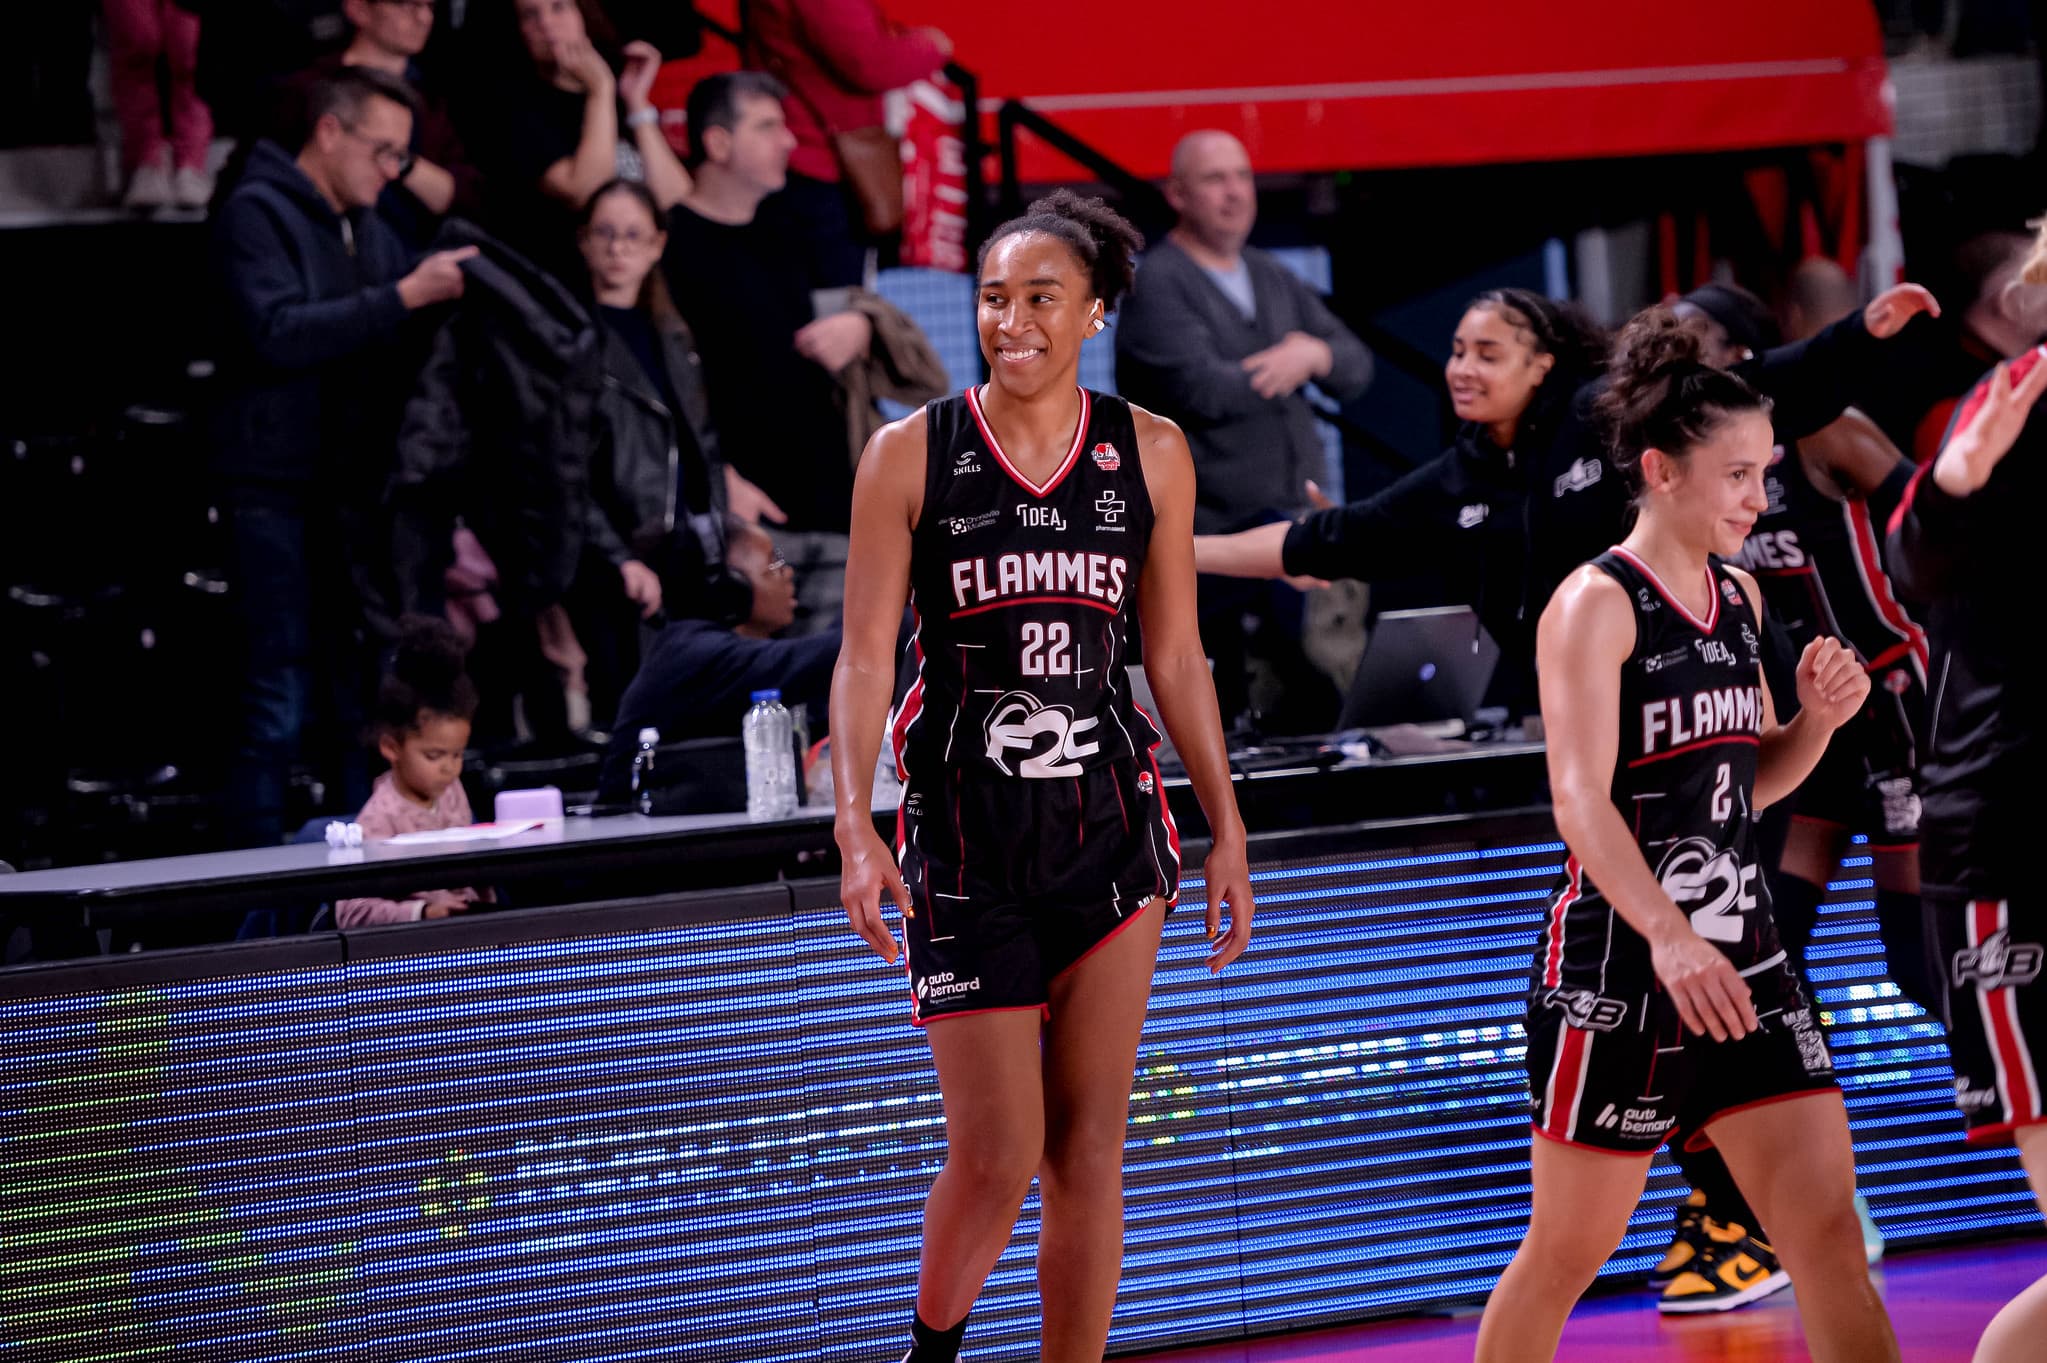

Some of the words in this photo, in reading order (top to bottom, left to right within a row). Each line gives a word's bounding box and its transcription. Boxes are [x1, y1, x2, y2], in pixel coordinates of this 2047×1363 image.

[953, 464, 981, 476] SKILLS
[1022, 506, 1062, 528] IDEA
[952, 552, 1127, 607] FLAMMES
[1021, 622, 1071, 676] 22
[1699, 640, 1732, 664] IDEA
[1643, 687, 1763, 754] FLAMME
[1711, 762, 1732, 822] 2
[929, 971, 955, 986] auto
[930, 976, 980, 998] bernard
[1623, 1107, 1657, 1120] auto
